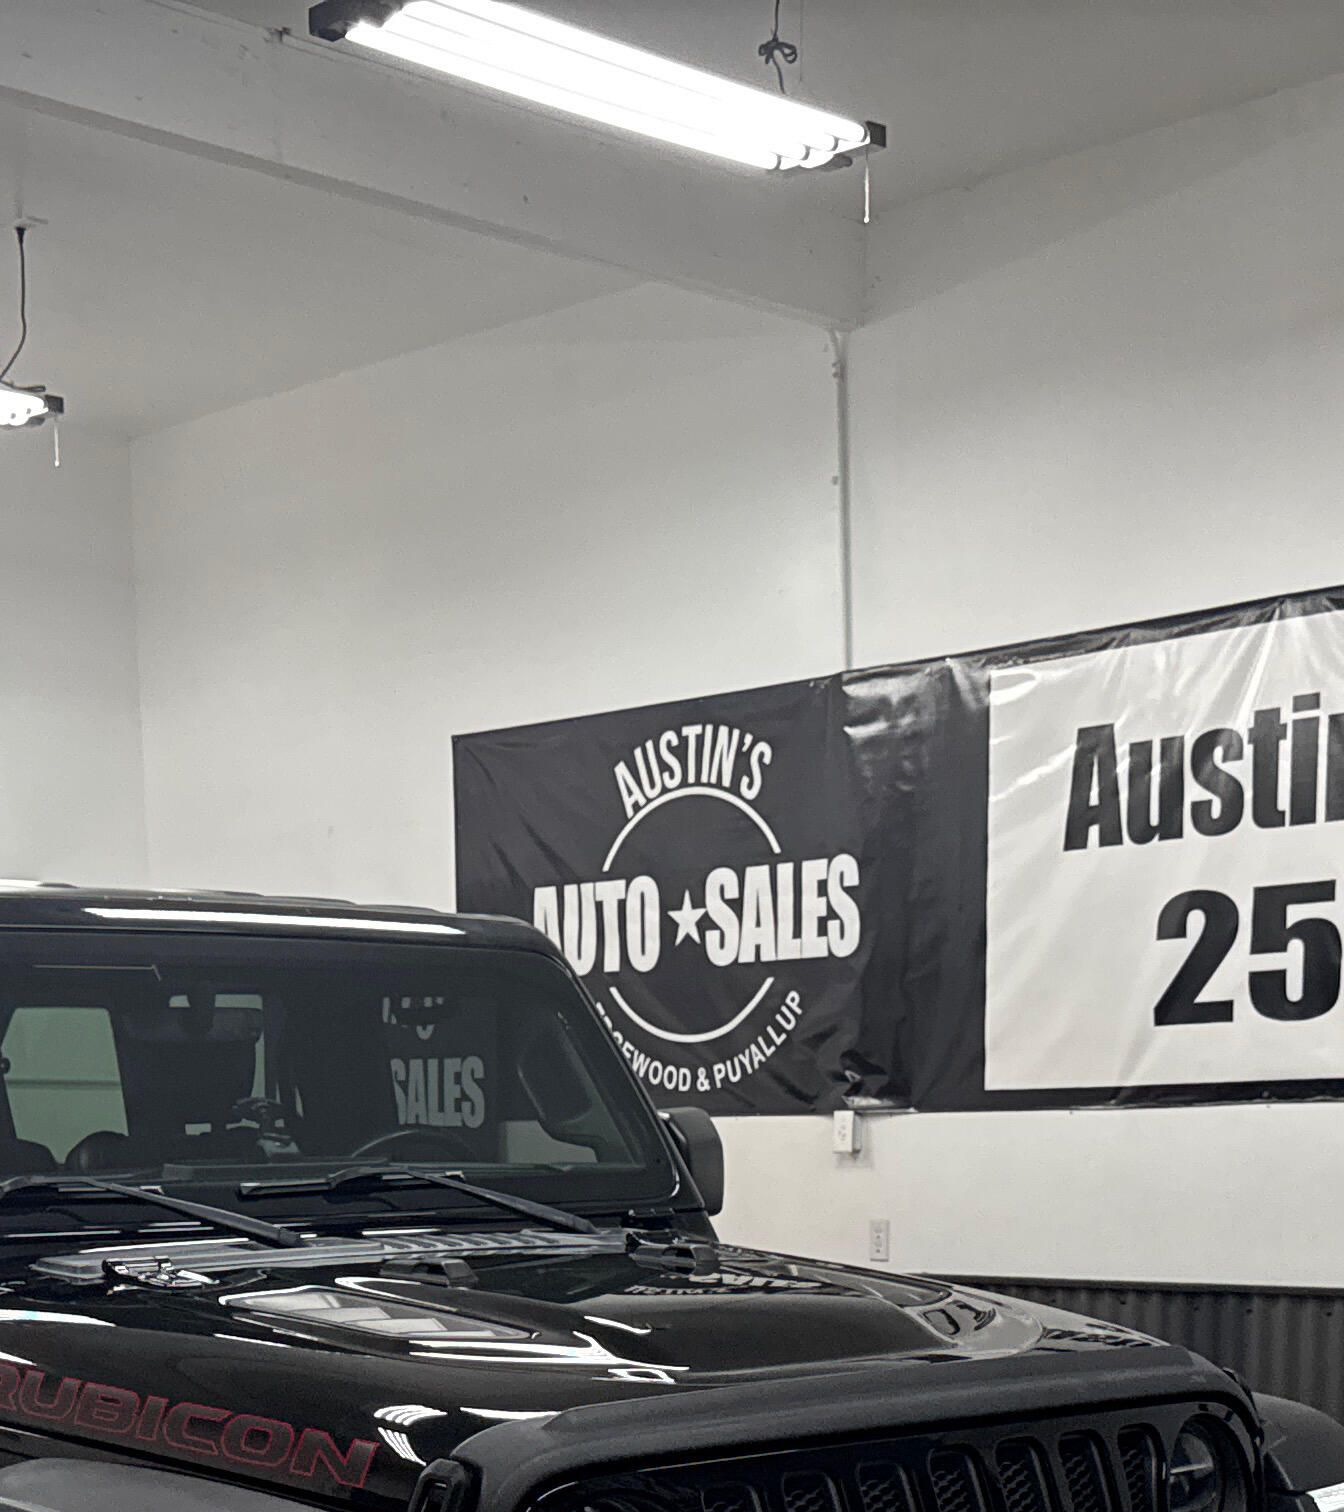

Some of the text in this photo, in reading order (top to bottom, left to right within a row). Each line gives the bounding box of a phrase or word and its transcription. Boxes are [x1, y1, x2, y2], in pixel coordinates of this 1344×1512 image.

[612, 723, 773, 819] AUSTIN'S
[532, 853, 861, 977] AUTO SALES
[594, 990, 803, 1092] EWOOD & PUYALLUP
[390, 1055, 485, 1129] SALES
